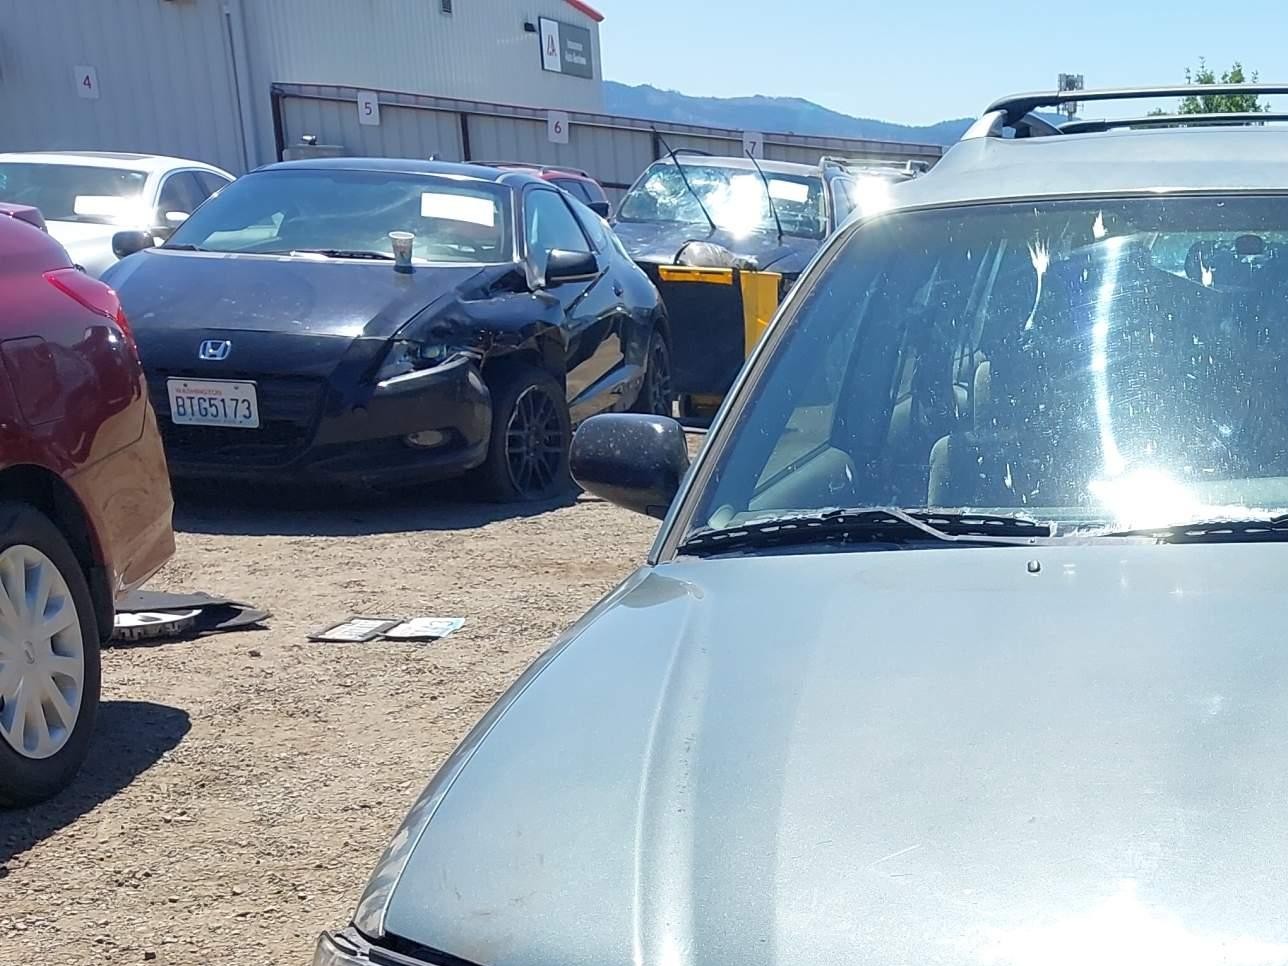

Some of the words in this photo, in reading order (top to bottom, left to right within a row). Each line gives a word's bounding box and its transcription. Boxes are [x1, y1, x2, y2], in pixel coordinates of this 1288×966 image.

[83, 74, 91, 89] 4
[364, 101, 372, 116] 5
[554, 120, 562, 134] 6
[749, 141, 757, 155] 7
[175, 396, 252, 420] BTG5173
